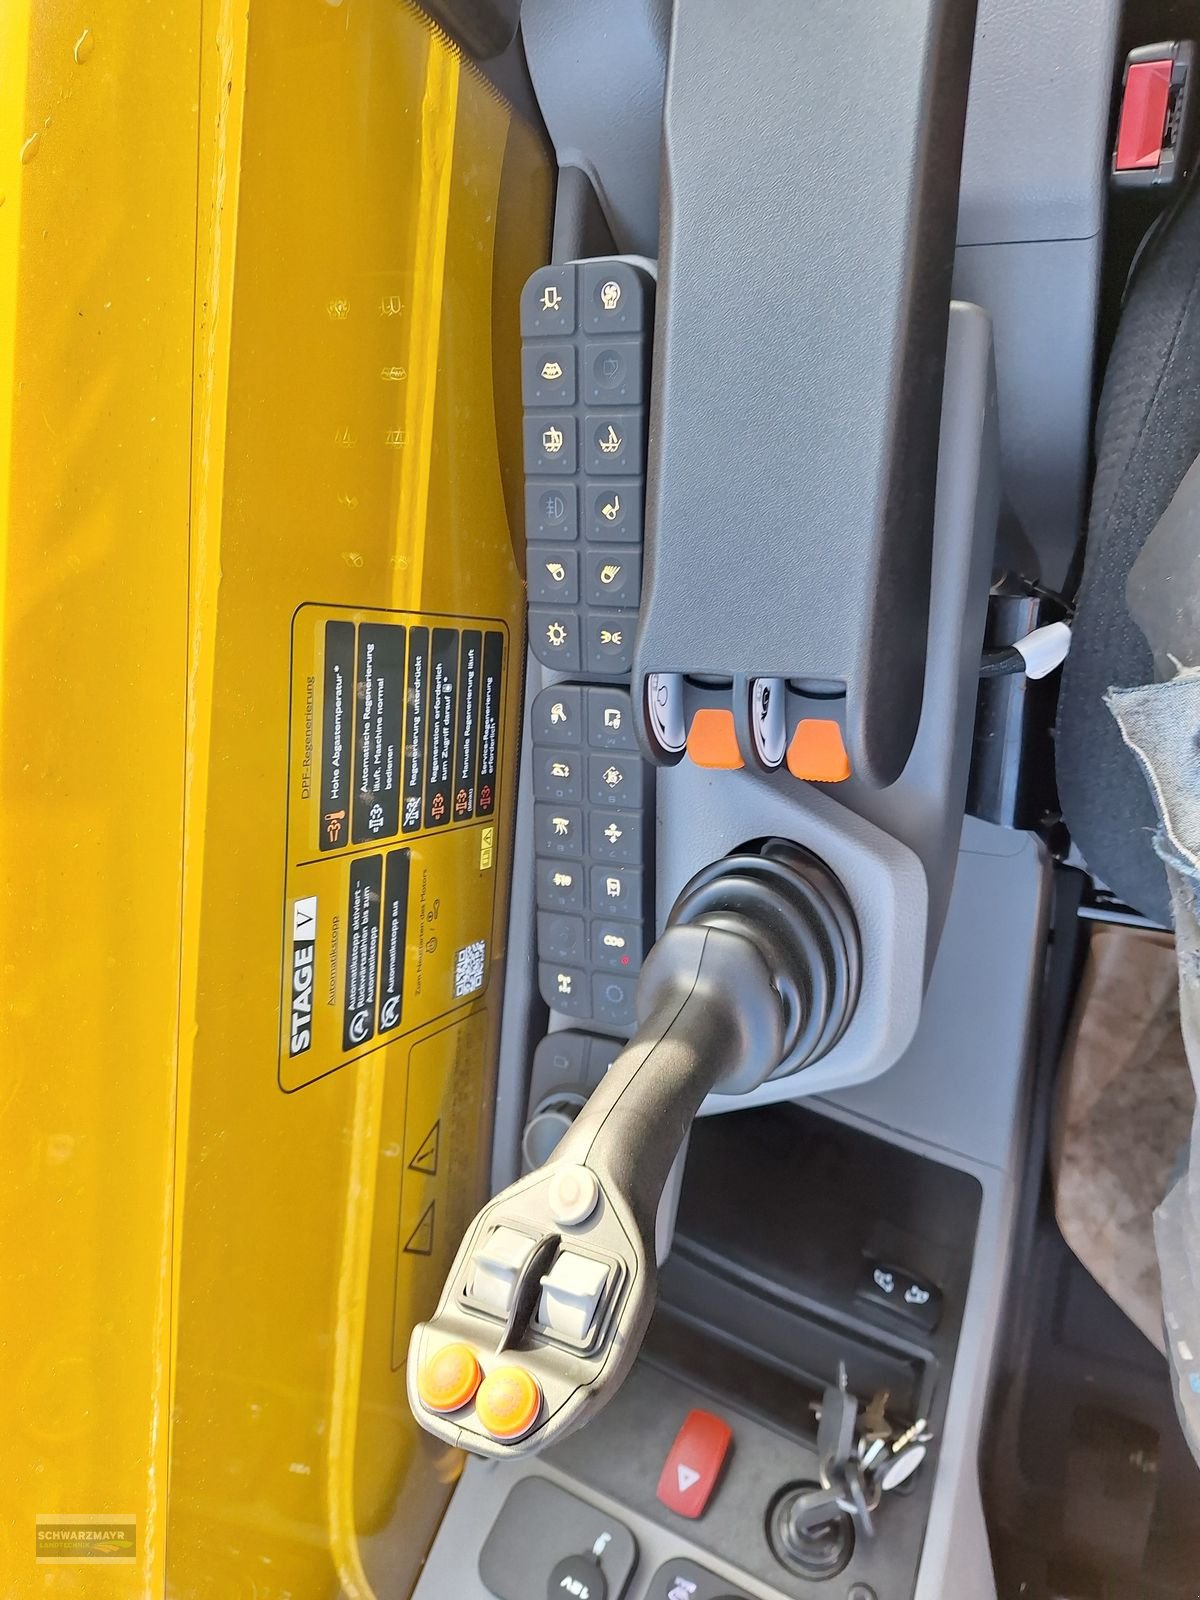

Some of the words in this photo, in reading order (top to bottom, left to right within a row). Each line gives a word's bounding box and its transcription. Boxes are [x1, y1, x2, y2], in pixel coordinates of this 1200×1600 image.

[363, 644, 374, 720] Regenerierung
[376, 678, 384, 714] normal
[413, 656, 422, 714] unterdrückt
[433, 663, 442, 719] erforderlich
[443, 695, 451, 725] darauf
[464, 672, 474, 736] Regenerierung
[301, 676, 314, 800] DPF-Regenerierung
[374, 717, 384, 764] Maschine
[410, 717, 420, 786] Regenerierung
[430, 722, 440, 783] Regeneration
[442, 727, 450, 758] Zugriff
[481, 677, 493, 774] Service-Regenerierung
[331, 769, 340, 799] Hohe
[361, 722, 370, 793] Automatische
[385, 745, 393, 789] bedienen
[462, 738, 470, 778] Manuelle
[297, 912, 313, 928] V
[352, 890, 361, 930] aktiviert
[361, 909, 369, 924] bis
[327, 916, 339, 1006] Automatikstopp
[348, 933, 360, 1010] Automatikstopp
[357, 926, 368, 1007] Rückwärtszählen
[366, 927, 378, 1003] Automatikstopp
[387, 919, 398, 993] Automatikstopp
[292, 945, 313, 1054] STAGE
